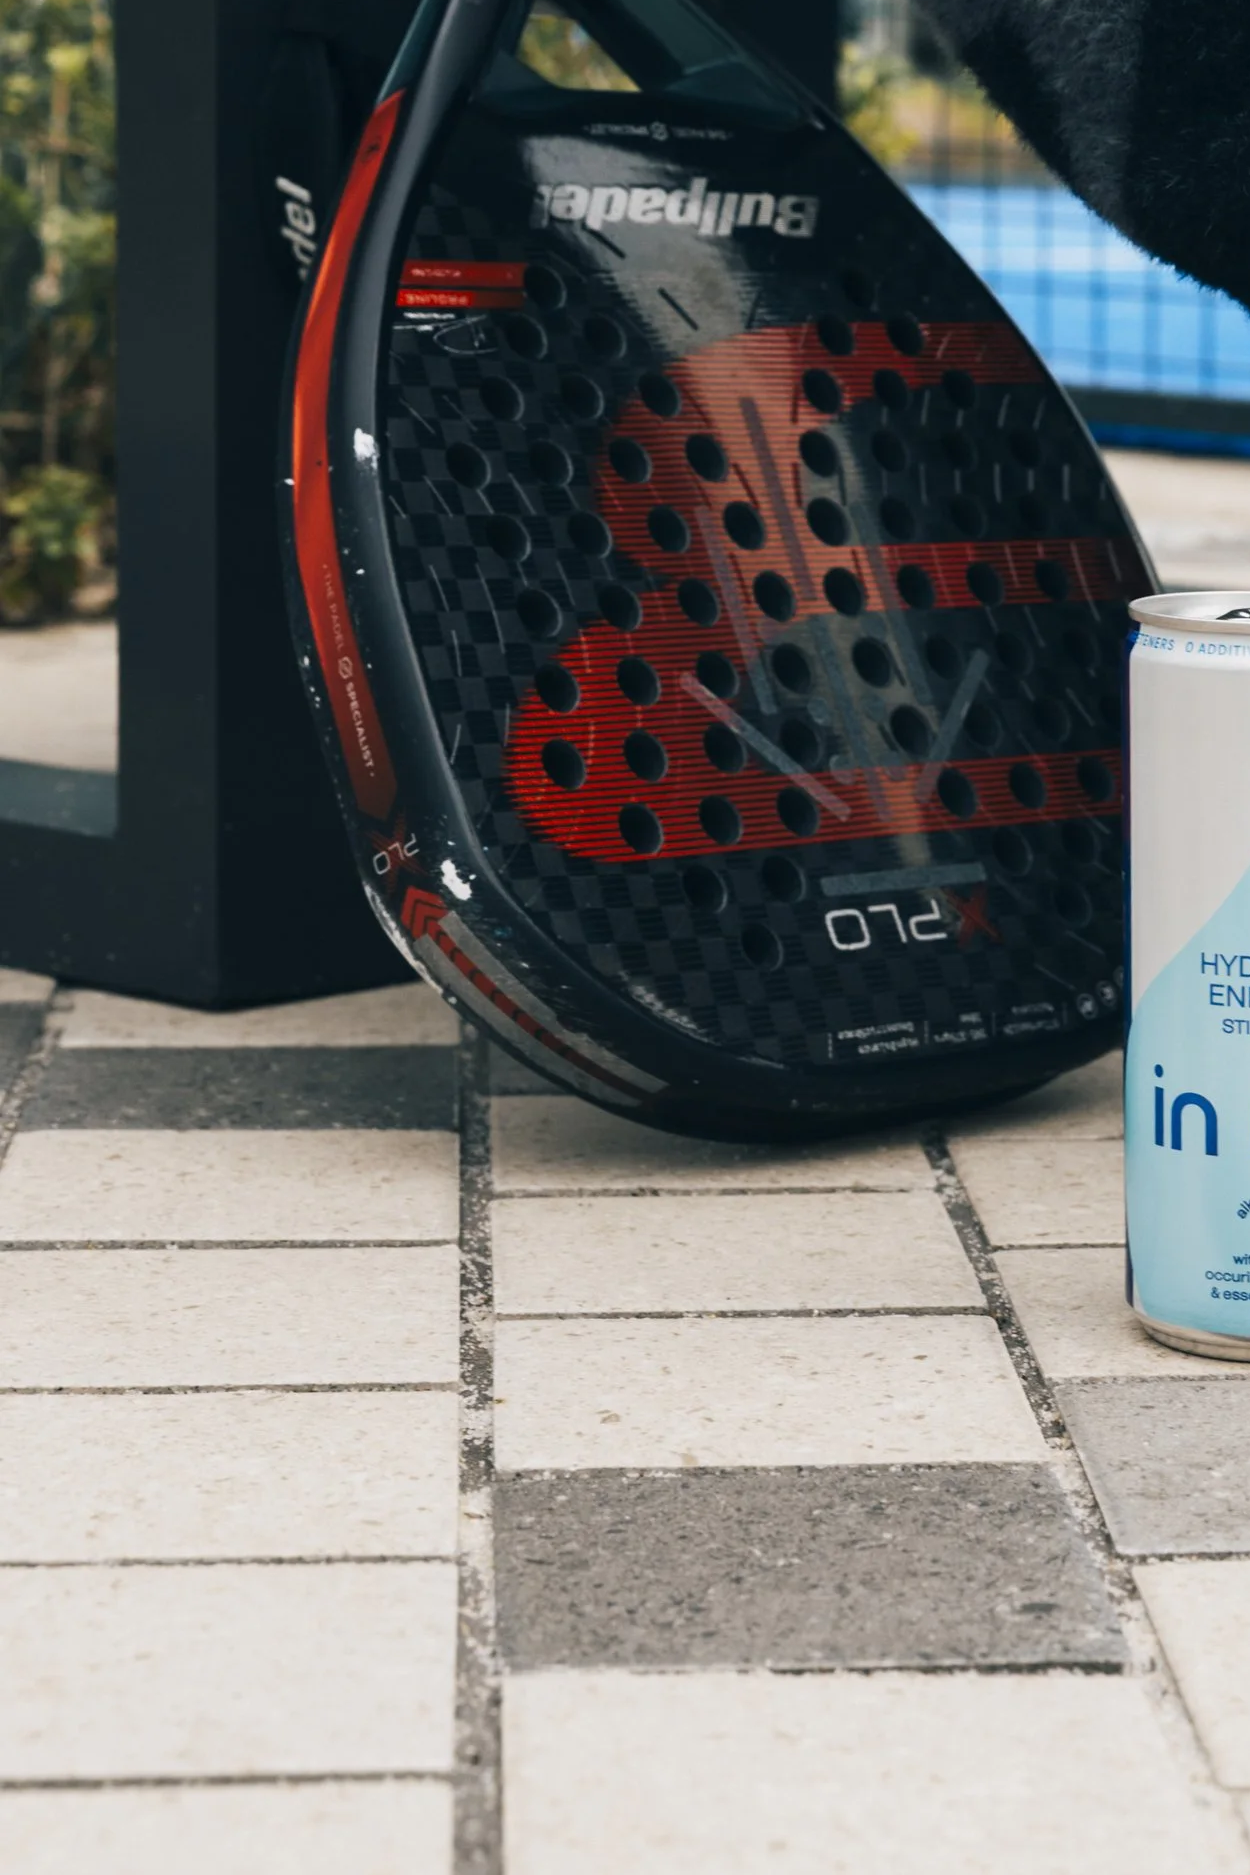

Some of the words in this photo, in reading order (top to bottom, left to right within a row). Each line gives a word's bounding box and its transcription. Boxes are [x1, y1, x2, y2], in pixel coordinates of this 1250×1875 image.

[345, 681, 375, 768] SPECIALIST
[1153, 1063, 1219, 1157] in
[1210, 1288, 1221, 1300] &
